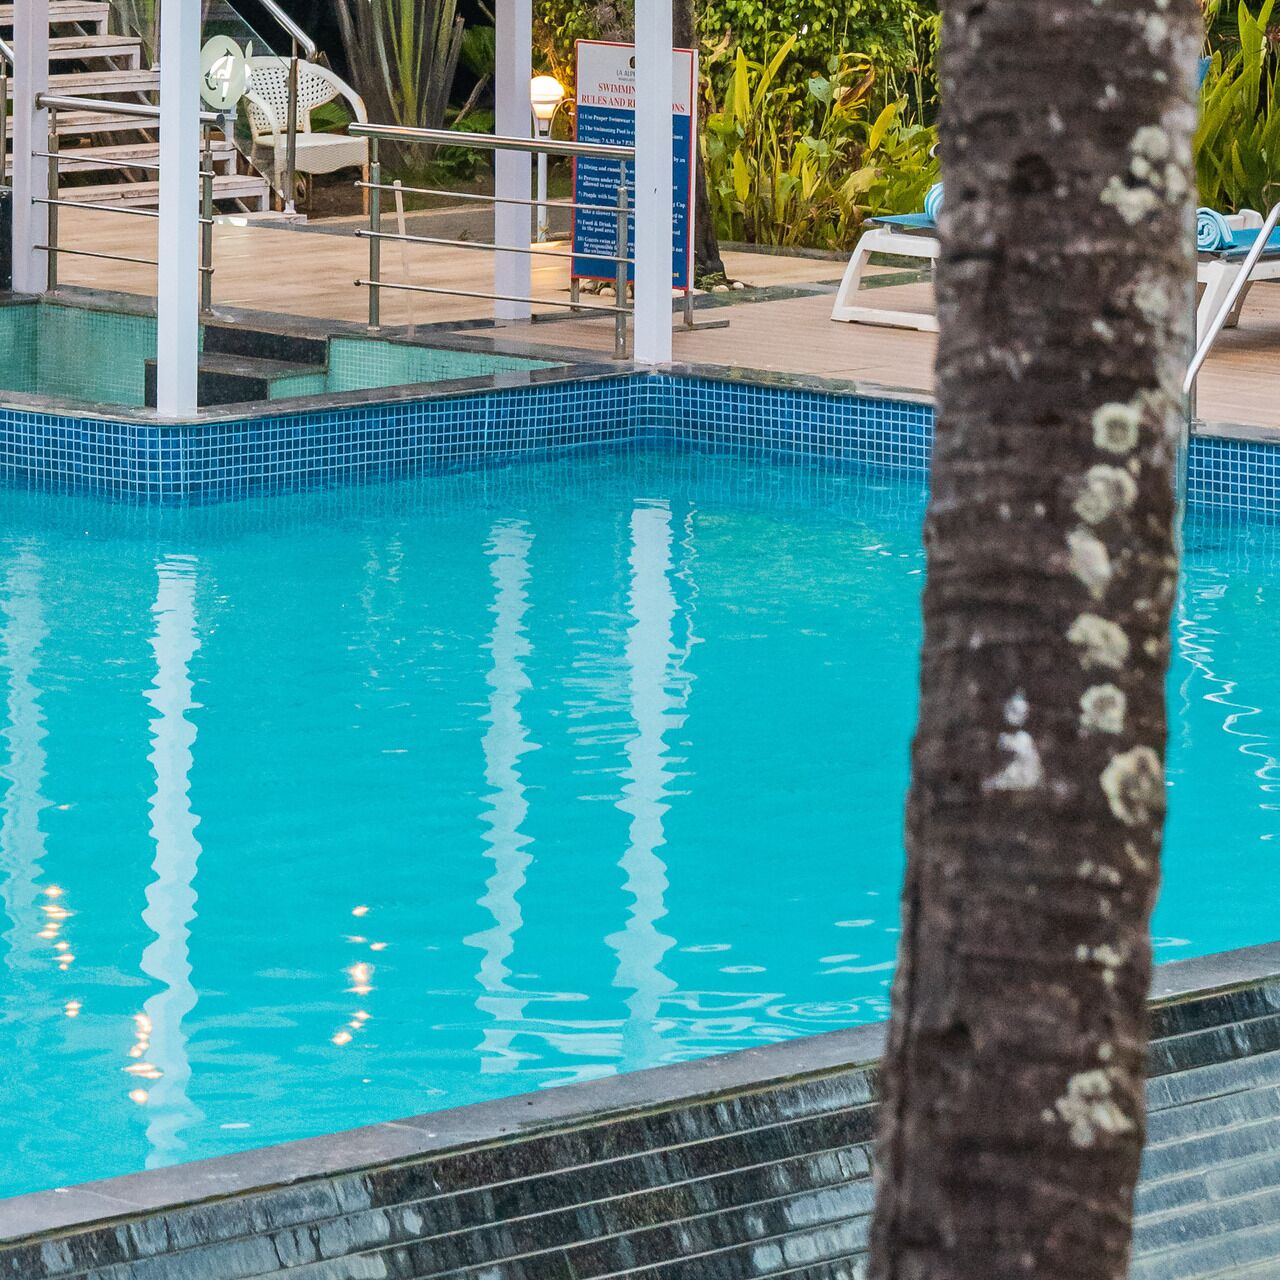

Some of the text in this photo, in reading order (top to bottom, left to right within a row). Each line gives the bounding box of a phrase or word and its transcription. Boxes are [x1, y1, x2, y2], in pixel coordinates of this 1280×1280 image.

[598, 82, 635, 94] SWIMMIN
[581, 93, 607, 105] RULES
[609, 96, 626, 107] AND
